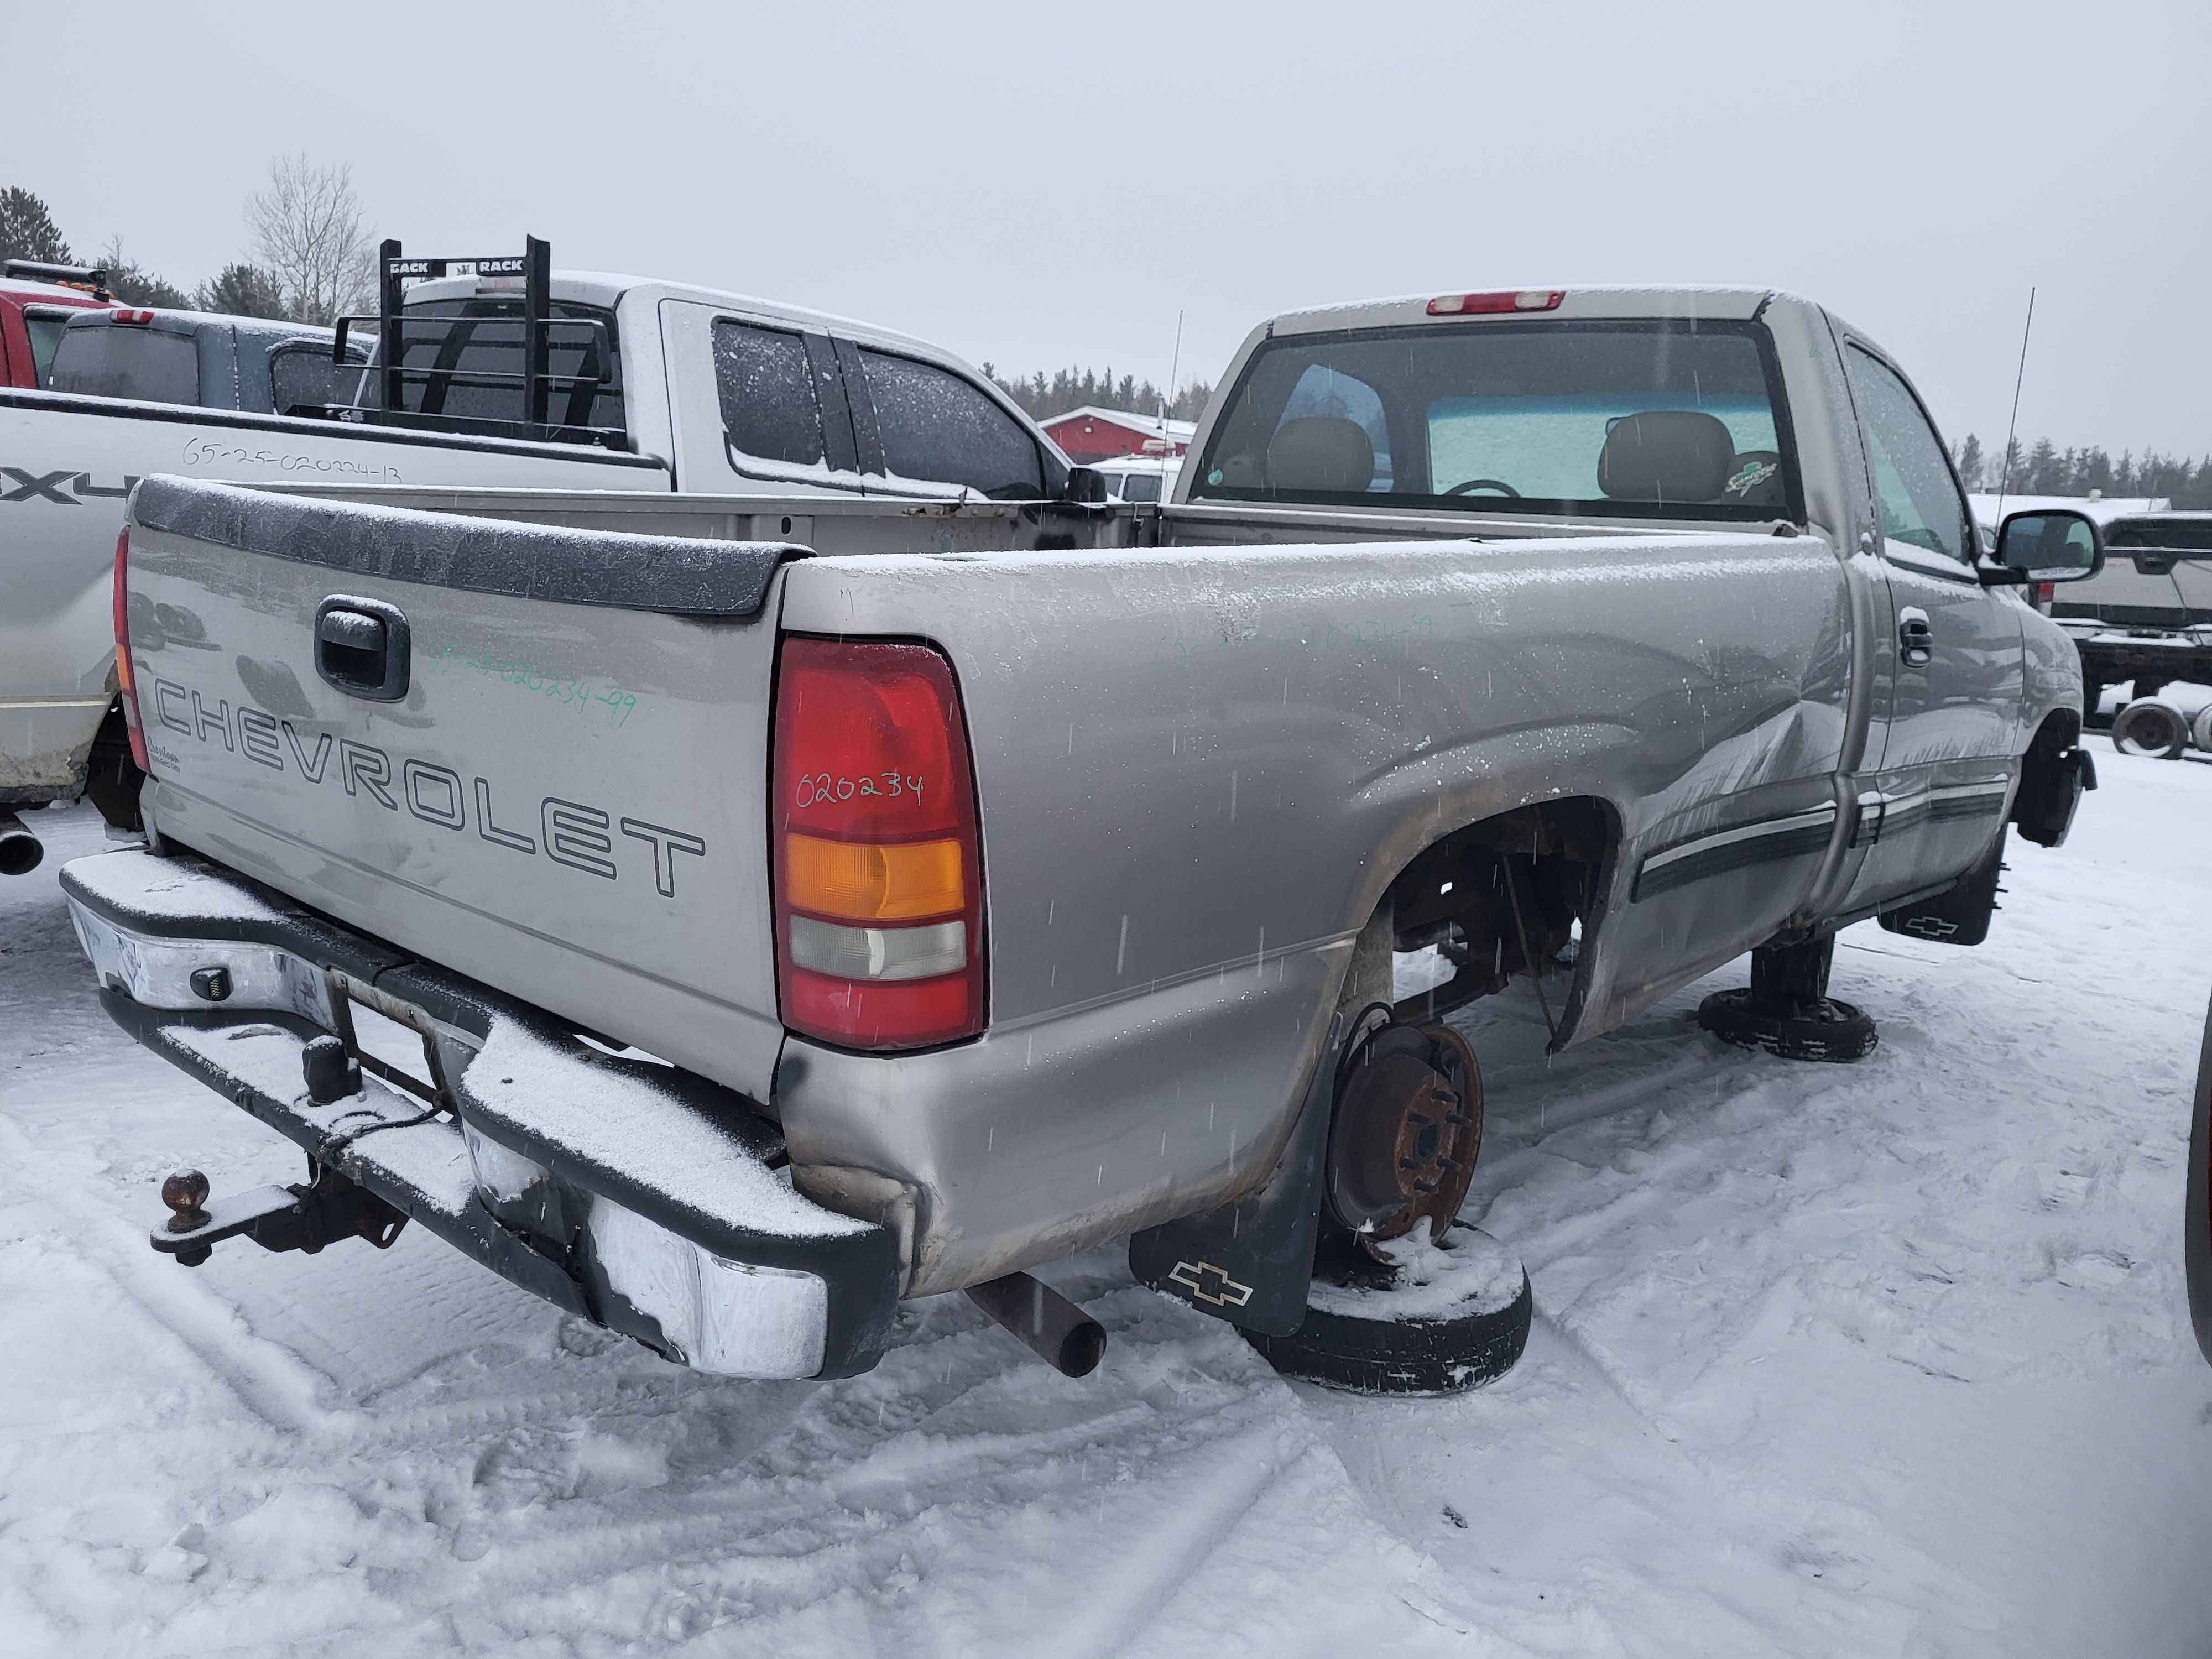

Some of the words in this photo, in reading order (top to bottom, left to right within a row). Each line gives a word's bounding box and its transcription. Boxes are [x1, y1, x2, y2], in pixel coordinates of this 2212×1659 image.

[479, 260, 523, 272] RACK
[155, 677, 706, 898] CHEVROLET
[796, 772, 924, 807] 020234
